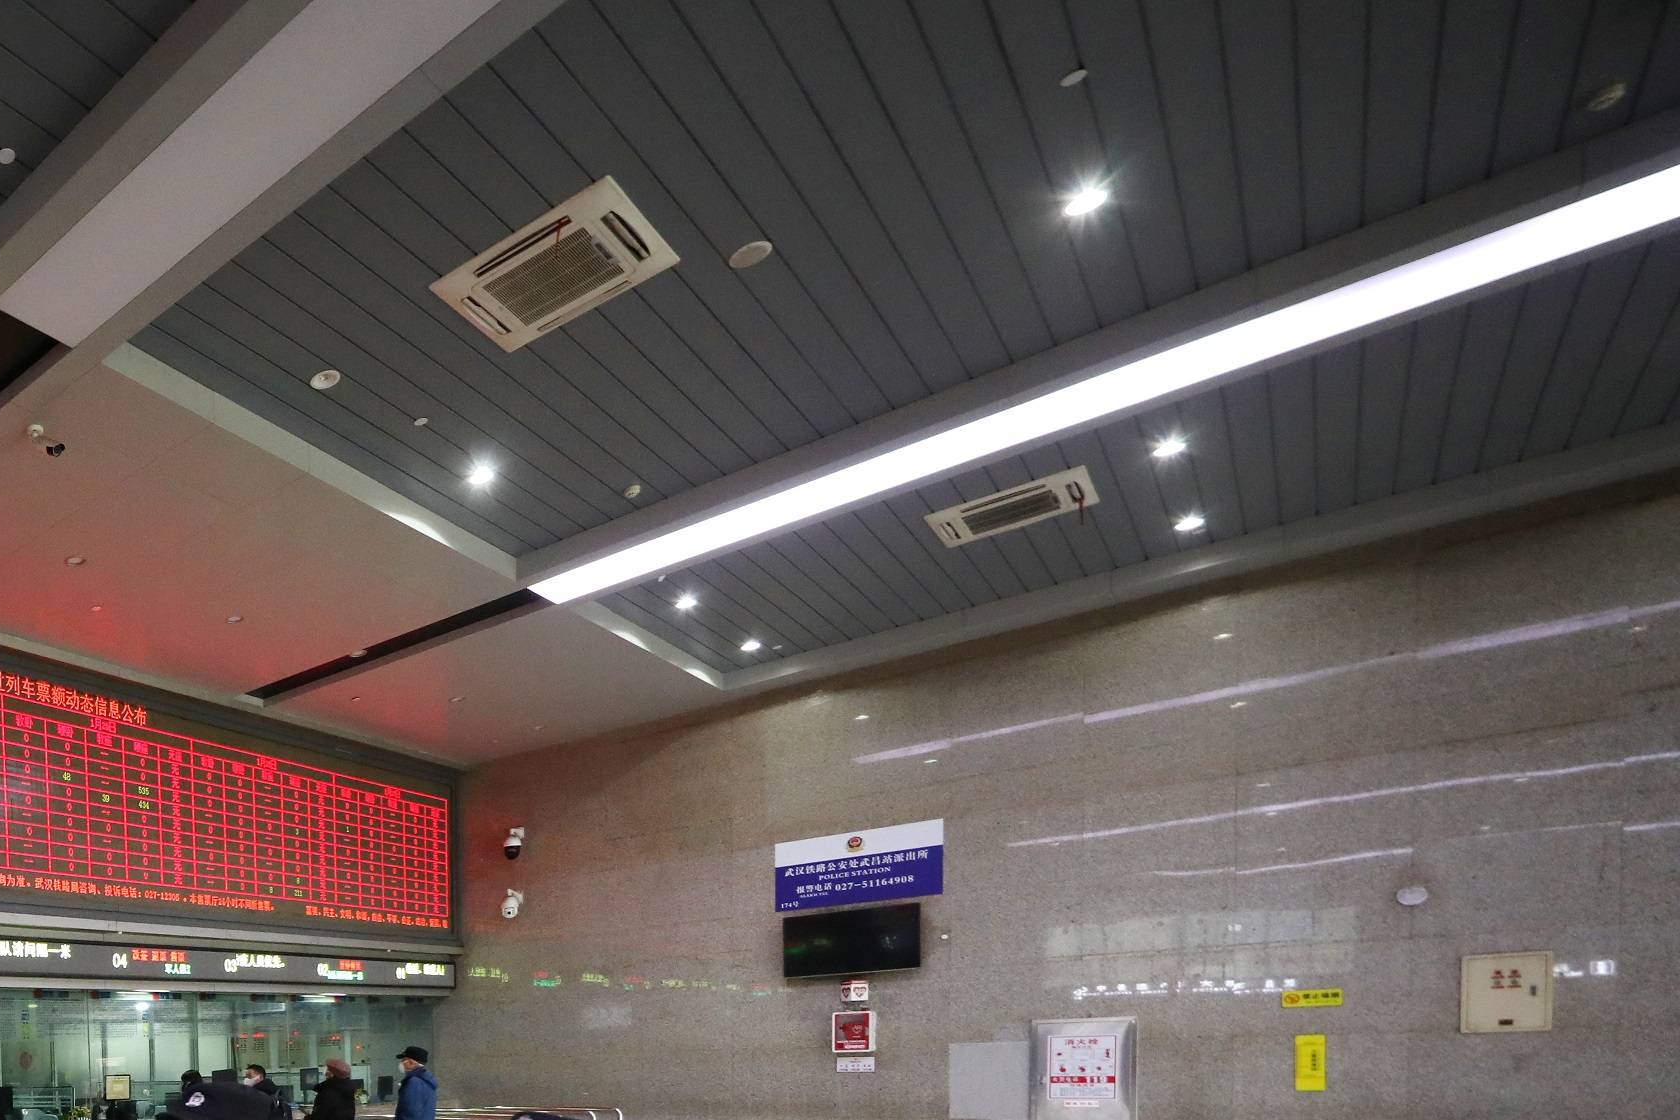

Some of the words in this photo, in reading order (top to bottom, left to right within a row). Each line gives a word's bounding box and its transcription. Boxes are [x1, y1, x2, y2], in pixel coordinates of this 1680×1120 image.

[785, 850, 928, 877] 武汉铁路公安处武昌站派出所
[819, 871, 849, 880] POLICE
[851, 866, 891, 877] STATION
[835, 875, 914, 891] 027-51164908
[113, 953, 127, 968] 04
[224, 958, 237, 973] 03
